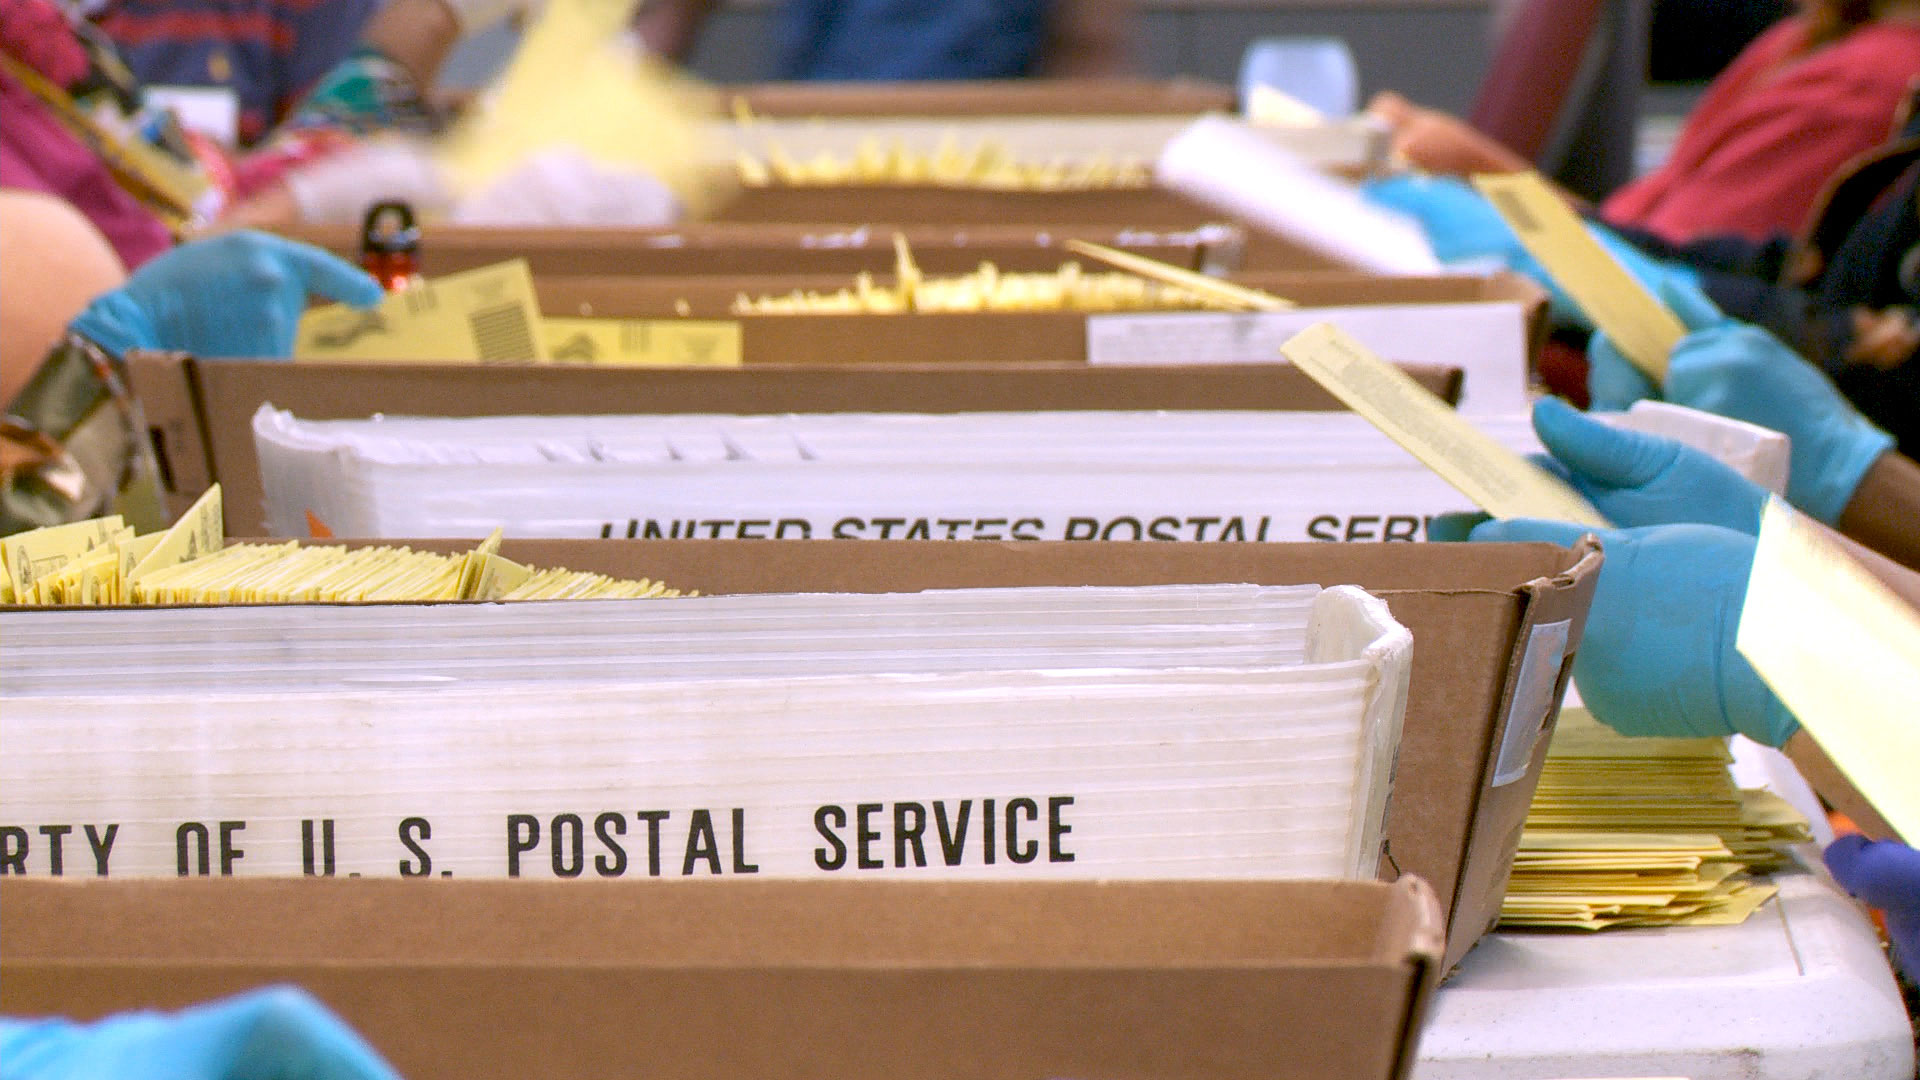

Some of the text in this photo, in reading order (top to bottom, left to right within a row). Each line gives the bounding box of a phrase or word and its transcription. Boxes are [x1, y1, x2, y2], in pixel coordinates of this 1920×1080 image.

[832, 517, 1045, 541] STATES
[1064, 515, 1270, 542] POSTAL
[1306, 515, 1434, 542] SER
[176, 820, 247, 878] OF
[507, 807, 760, 879] POSTAL
[813, 796, 1076, 871] SERVICE
